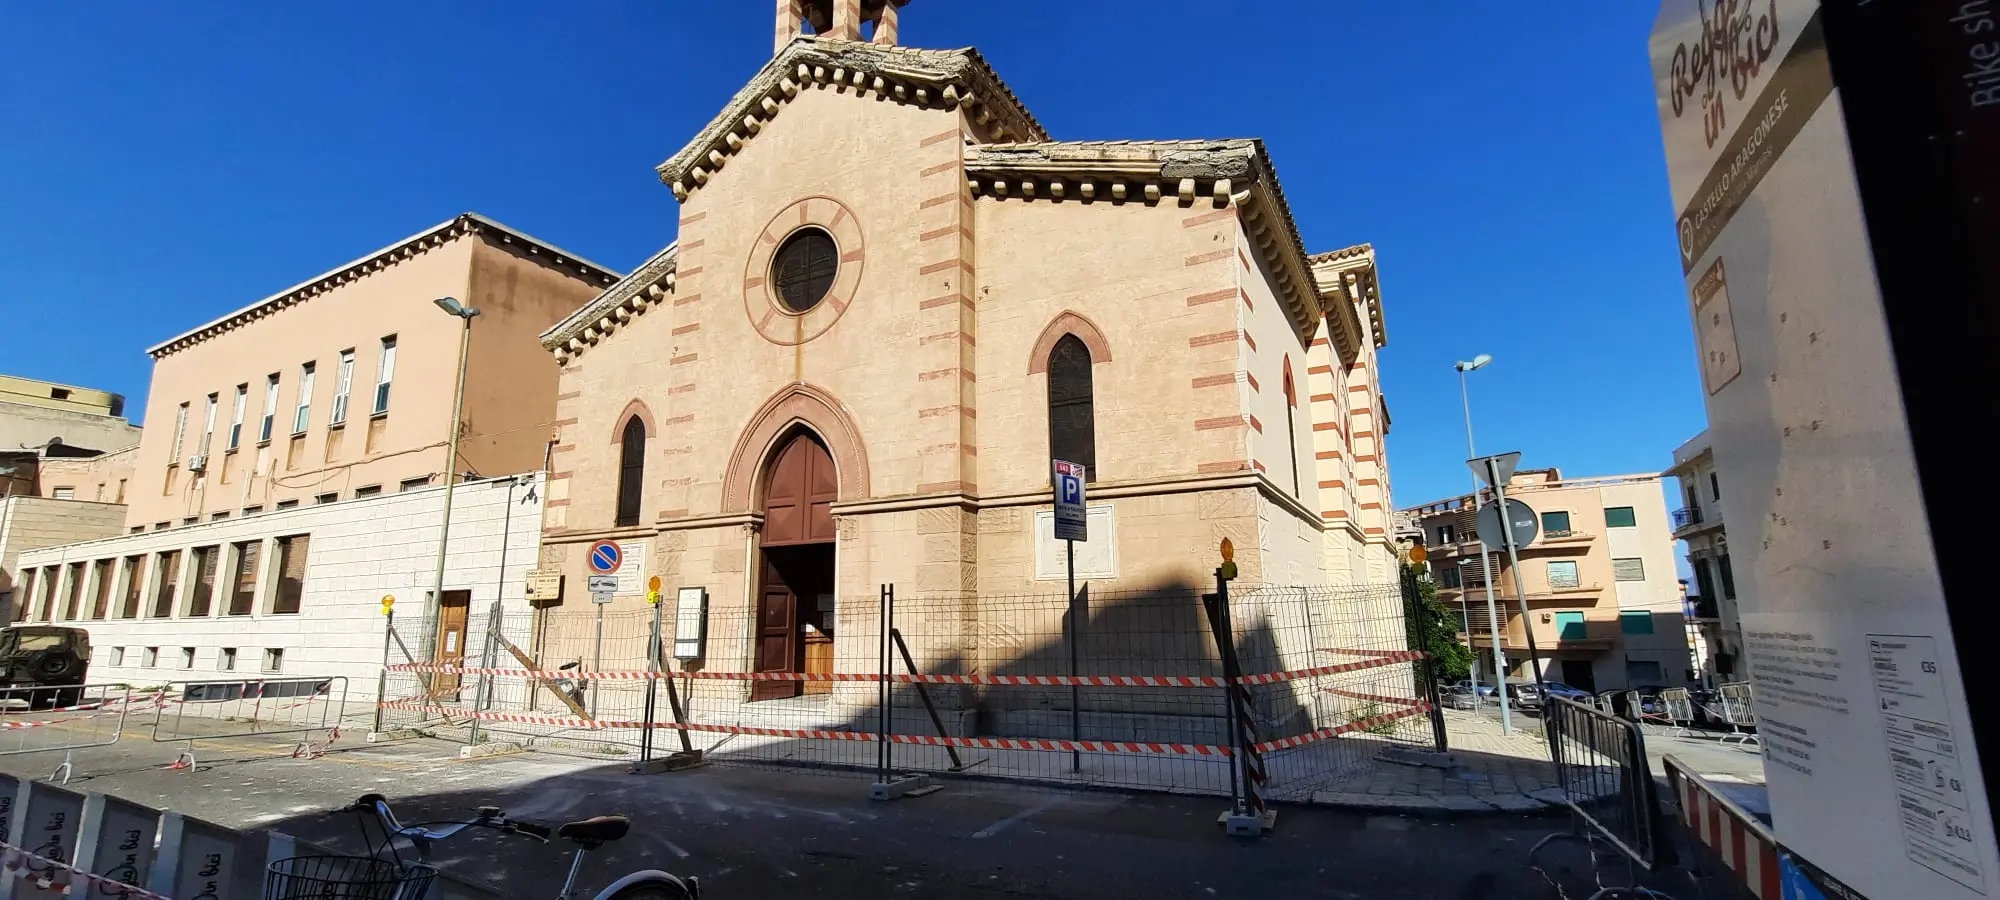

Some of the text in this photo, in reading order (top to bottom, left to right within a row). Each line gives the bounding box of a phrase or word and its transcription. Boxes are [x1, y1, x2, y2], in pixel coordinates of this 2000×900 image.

[1703, 0, 1779, 149] in bici
[1962, 41, 2000, 108] Bike
[1695, 173, 1730, 229] CASTELLO
[1730, 88, 1789, 181] ARAGONESE
[1066, 478, 1077, 501] P
[44, 812, 65, 831] bici
[119, 829, 141, 850] bici
[198, 853, 221, 877] bici
